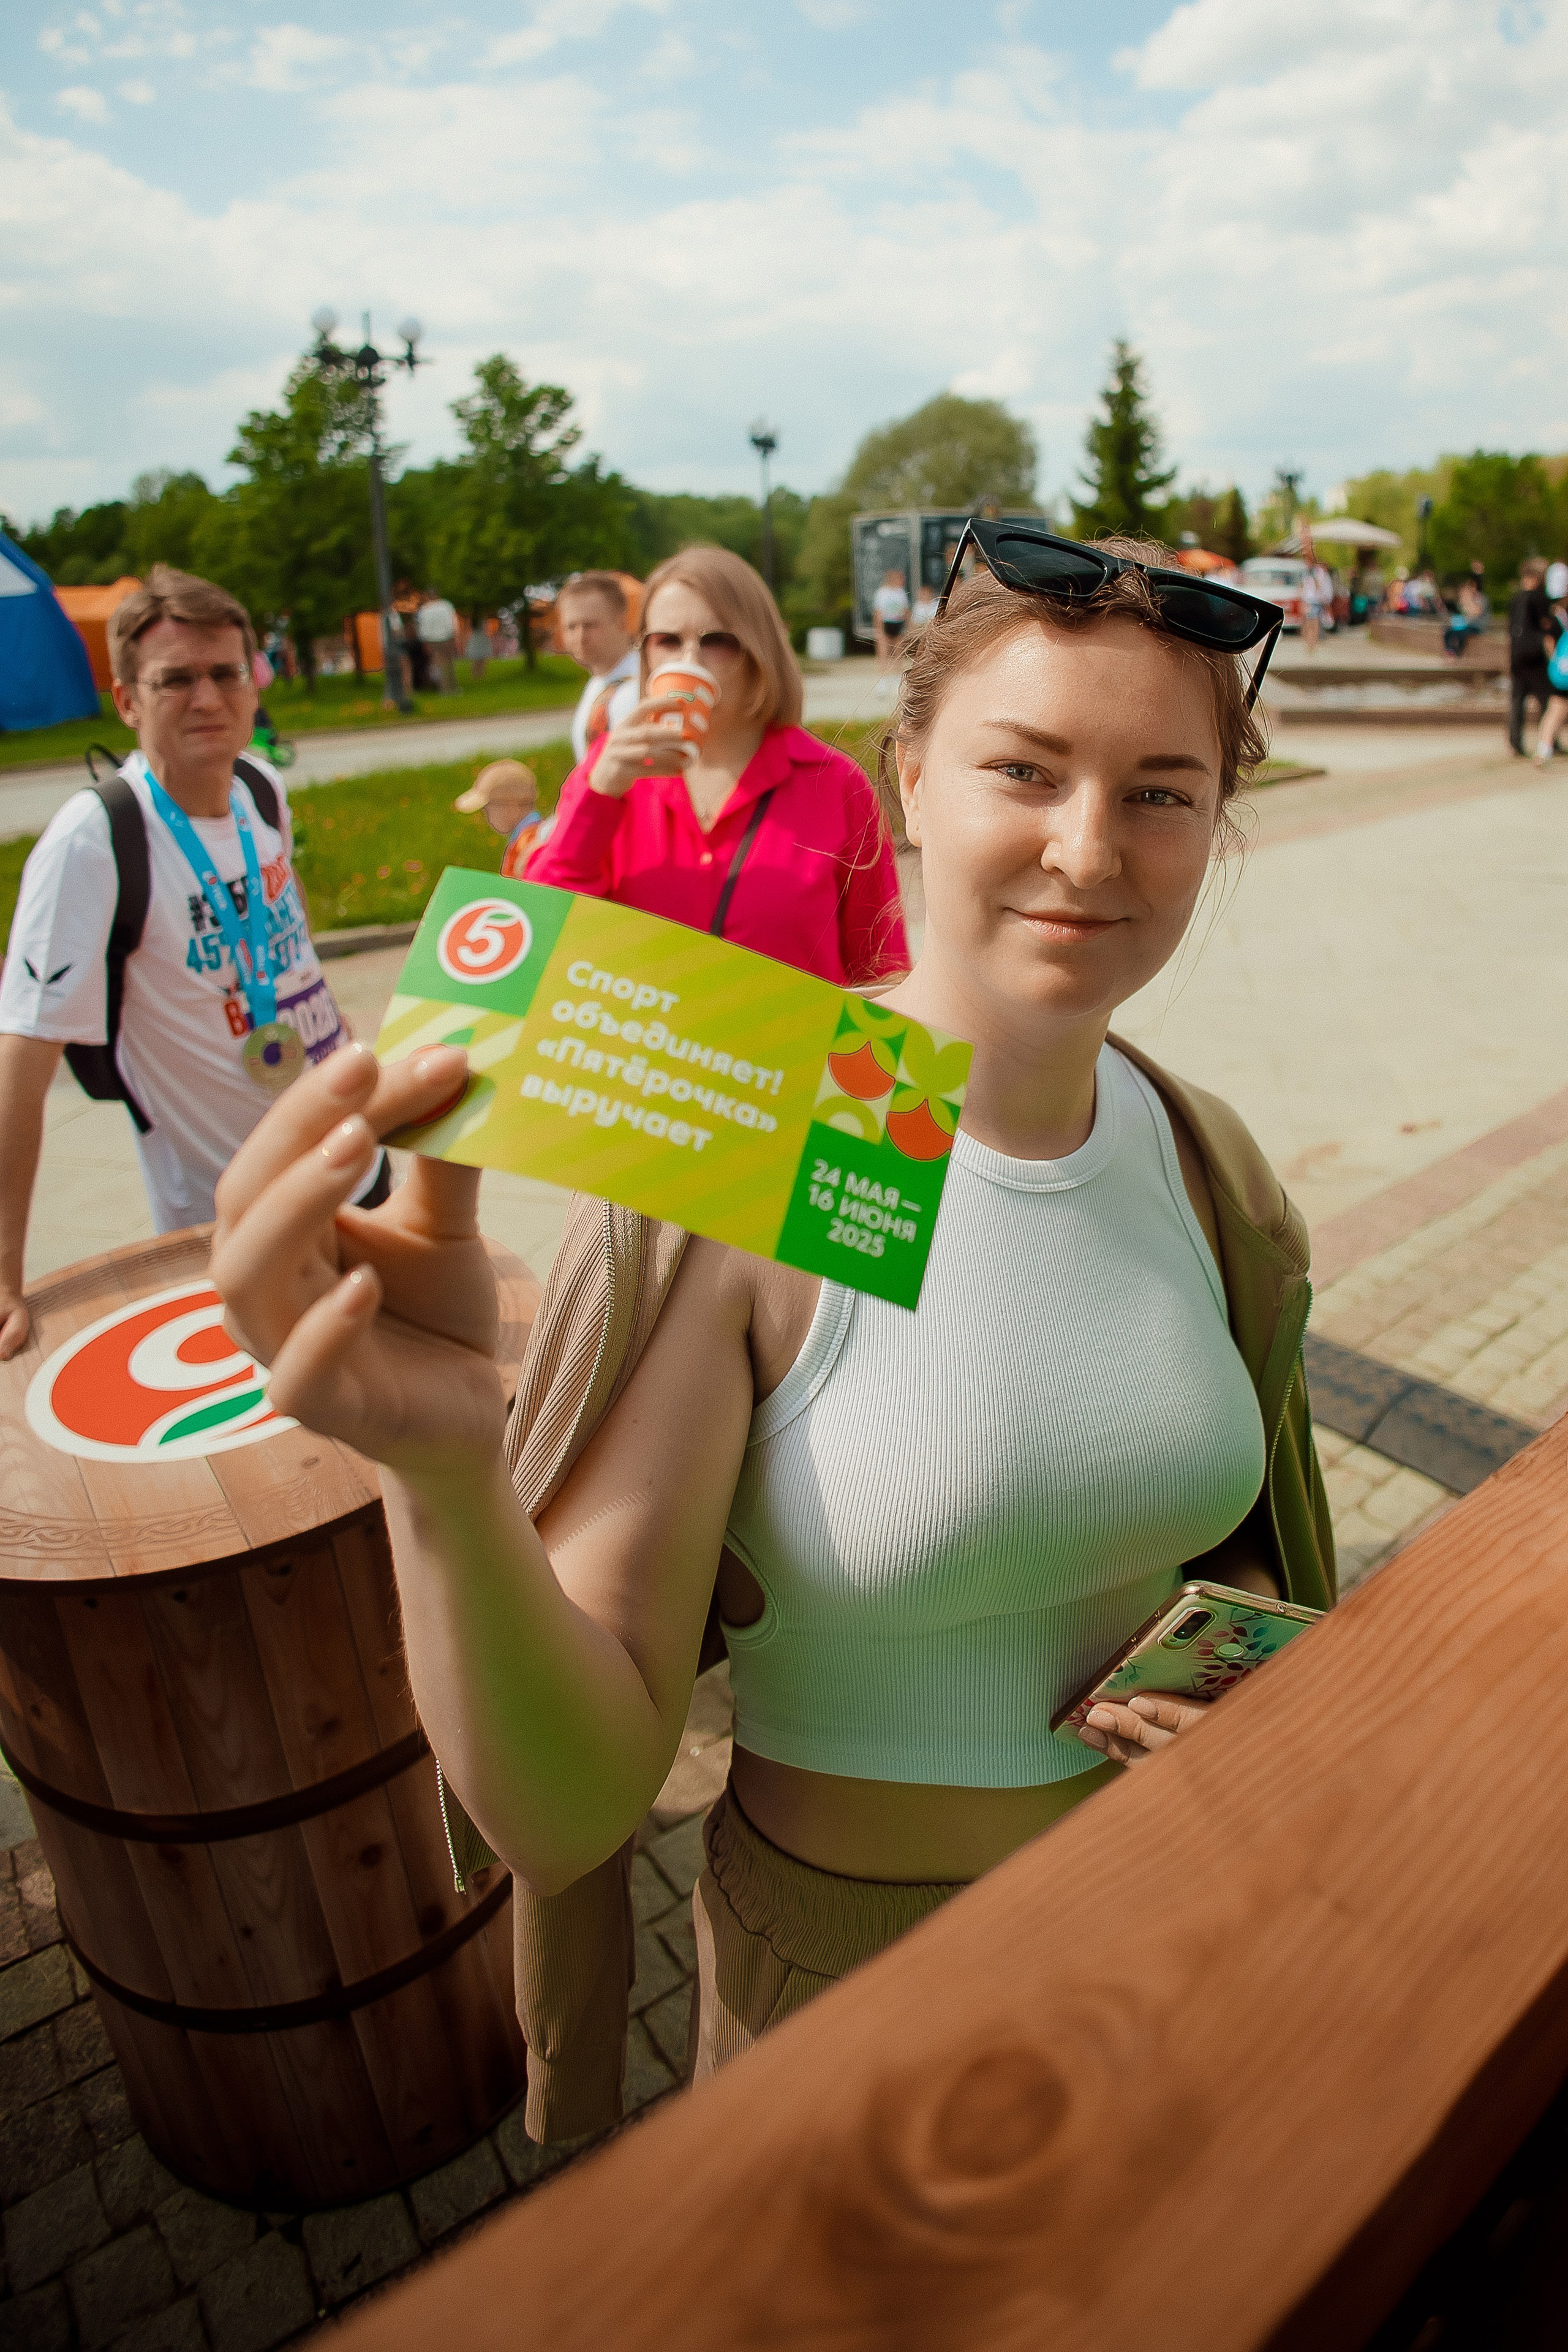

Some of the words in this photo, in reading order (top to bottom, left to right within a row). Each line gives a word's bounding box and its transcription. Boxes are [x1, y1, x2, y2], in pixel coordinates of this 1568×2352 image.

[567, 960, 680, 1014] Спорт
[551, 999, 785, 1096] объединяет!
[520, 1074, 713, 1152] выручает
[536, 1035, 778, 1133] «Пятёрочка»
[808, 1183, 835, 1212] 16
[838, 1194, 918, 1243] ИЮНЯ
[811, 1158, 842, 1188] 24
[844, 1171, 900, 1211] МАЯ
[826, 1217, 886, 1258] 2025
